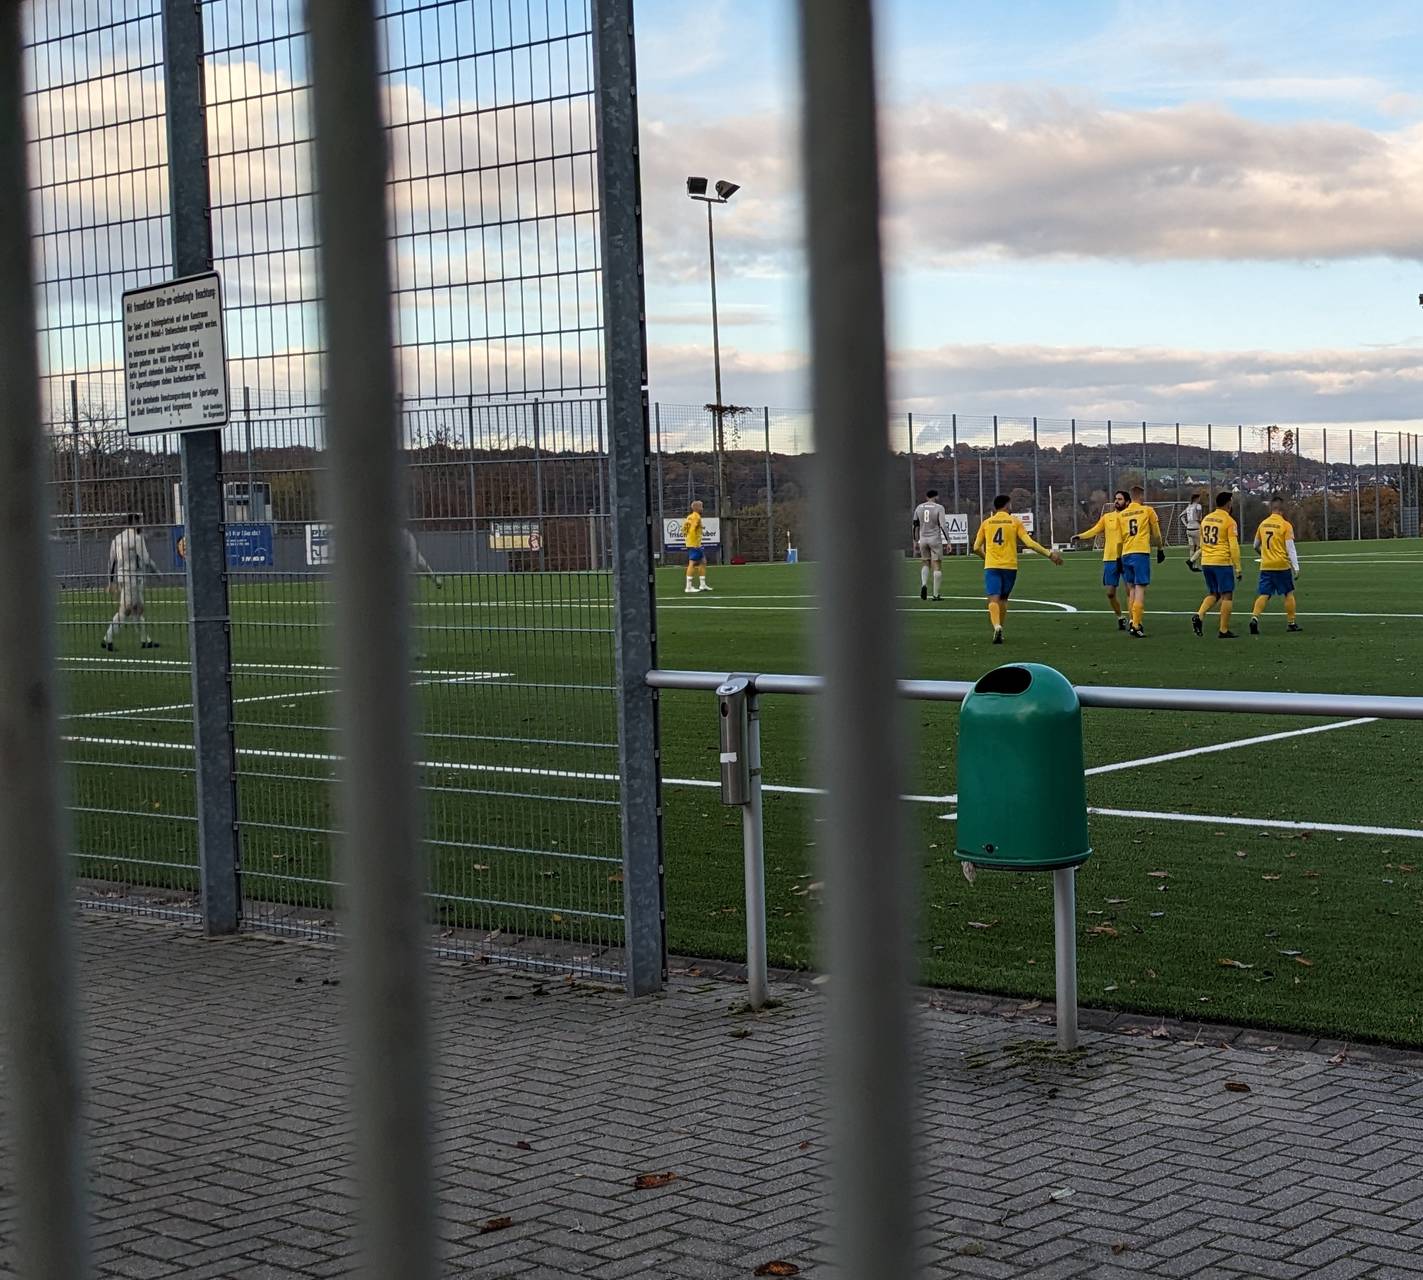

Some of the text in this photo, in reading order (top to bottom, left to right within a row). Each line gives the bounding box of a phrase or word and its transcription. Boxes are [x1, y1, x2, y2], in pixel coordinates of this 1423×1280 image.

[923, 509, 930, 523] 8
[993, 527, 1004, 546] 4
[1129, 519, 1138, 536] 6
[1203, 525, 1219, 544] 33
[1265, 531, 1274, 550] 7
